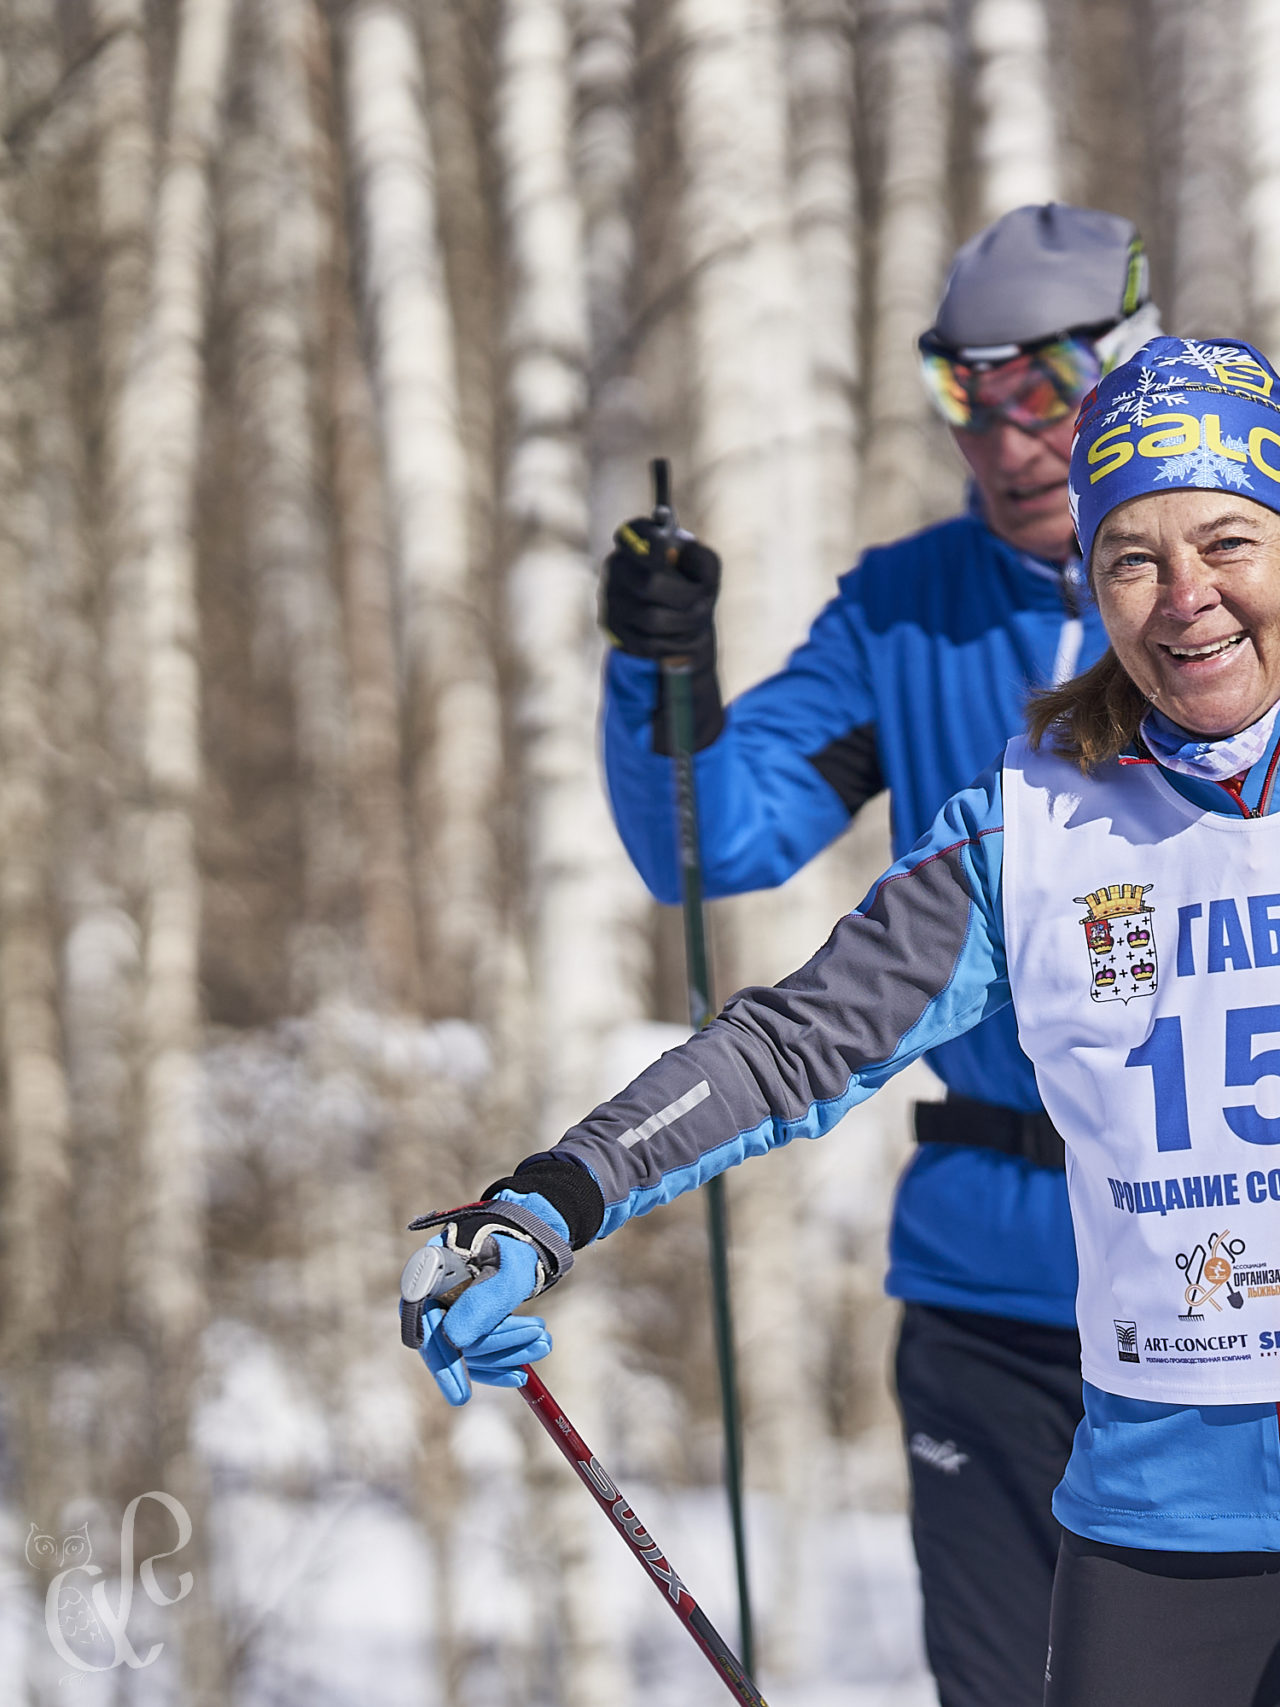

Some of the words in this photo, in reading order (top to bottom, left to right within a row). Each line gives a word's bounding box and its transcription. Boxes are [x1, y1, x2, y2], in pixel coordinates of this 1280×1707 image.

[1107, 1175, 1241, 1216] ПРОЩАНИЕ
[1232, 1262, 1267, 1270] АССОЦИАЦИЯ
[1144, 1334, 1248, 1351] ART-CONCEPT
